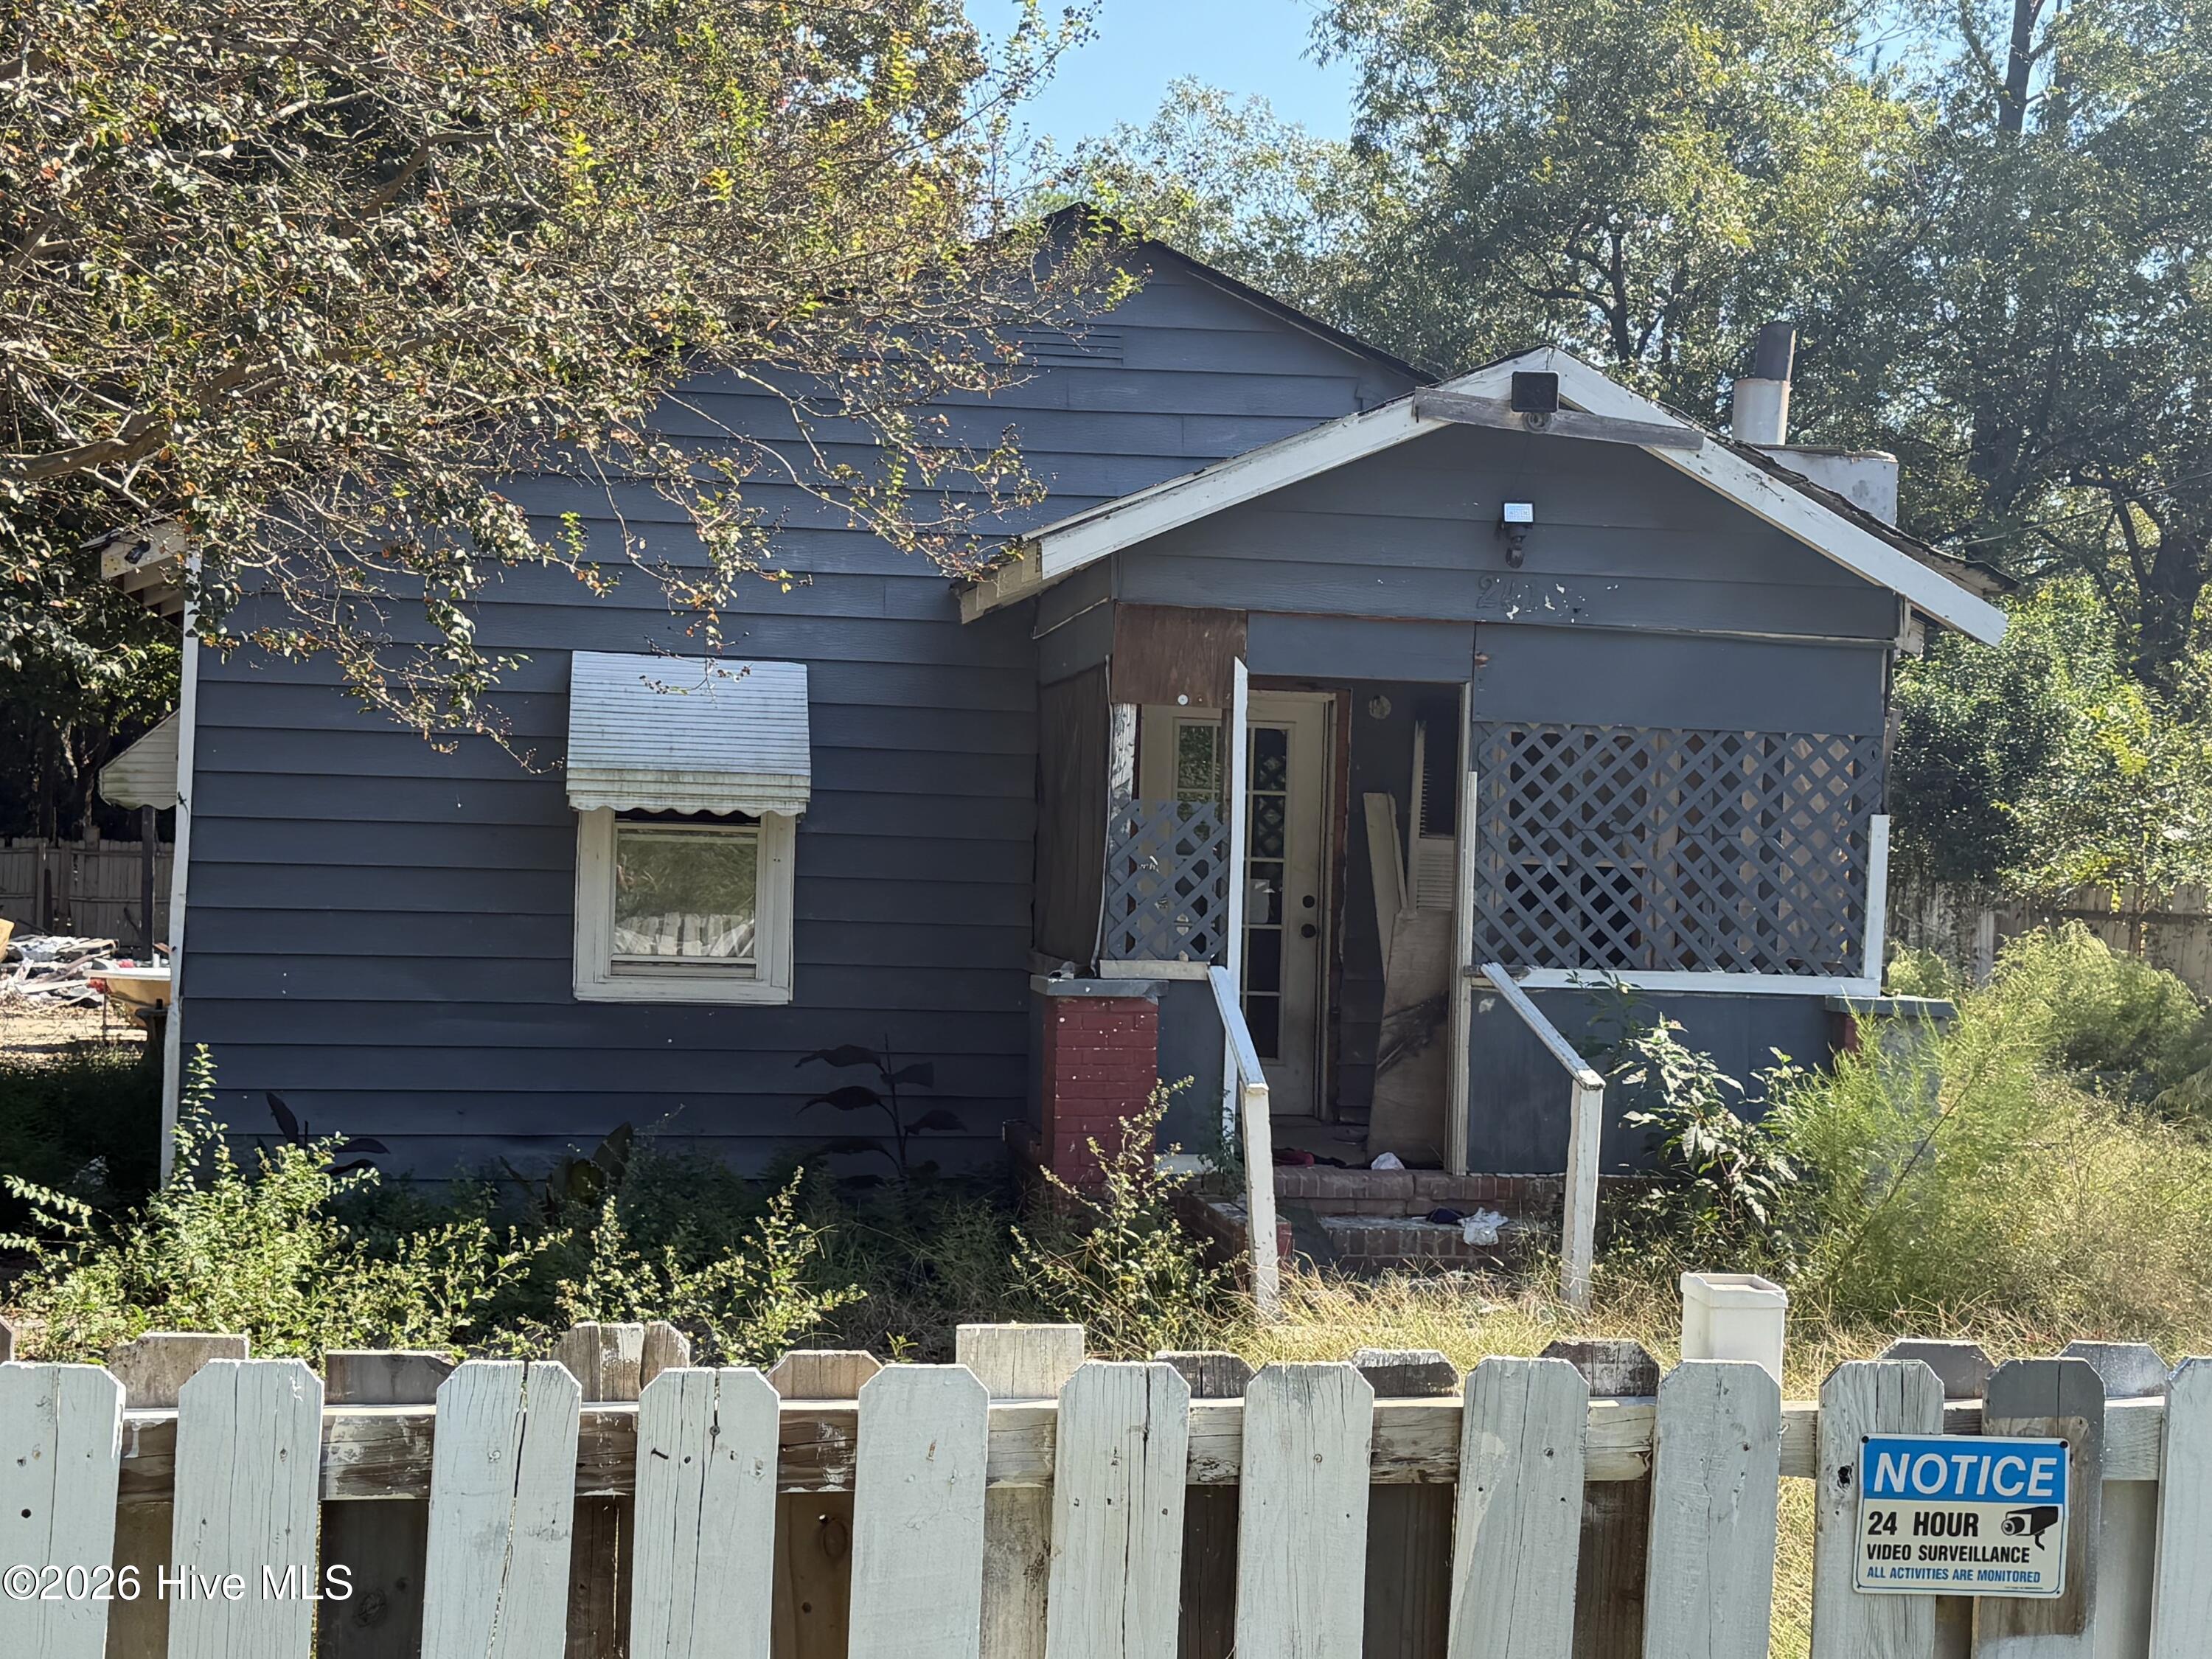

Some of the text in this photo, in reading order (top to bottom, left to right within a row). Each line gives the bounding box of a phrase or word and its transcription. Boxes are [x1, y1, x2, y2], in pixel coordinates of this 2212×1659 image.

[1874, 1453, 2058, 1497] NOTICE
[1868, 1511, 1979, 1537] 24 HOUR
[1866, 1544, 2030, 1563] VIDEO SURVEILLANCE
[1867, 1567, 2041, 1583] ALL ACTIVITIES ARE MONITORED
